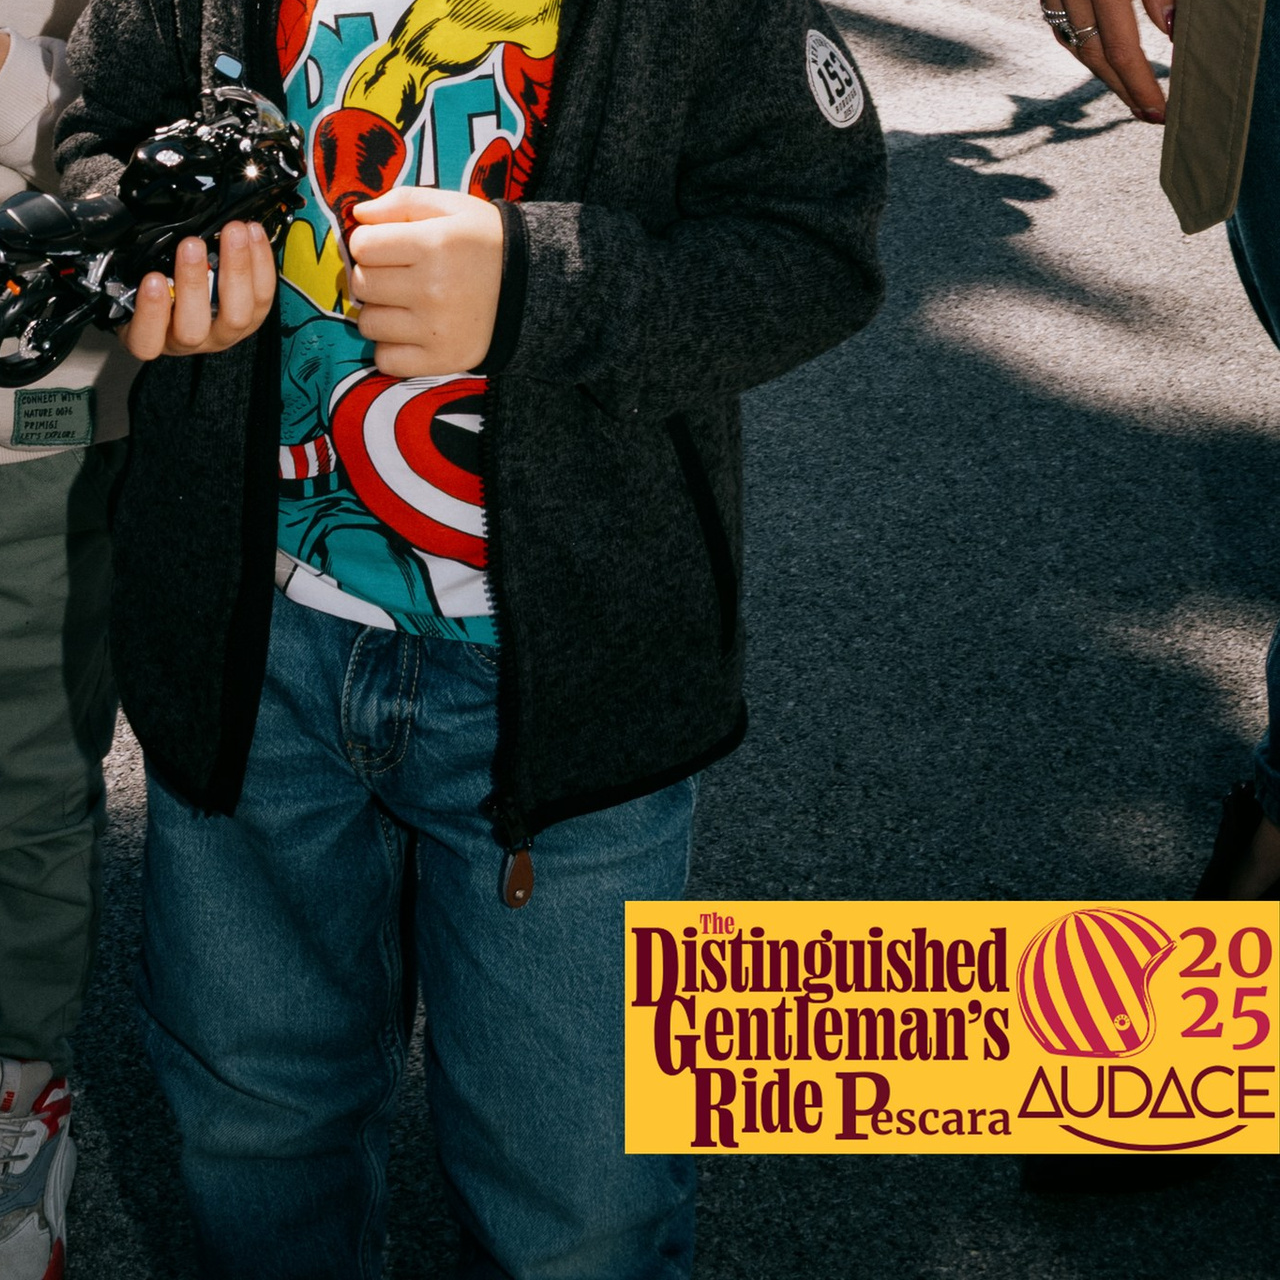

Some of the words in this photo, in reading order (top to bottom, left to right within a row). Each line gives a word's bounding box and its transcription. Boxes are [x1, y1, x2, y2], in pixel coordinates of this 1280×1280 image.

[817, 51, 853, 107] 153
[22, 394, 56, 404] CONNECT
[61, 392, 81, 402] WITH
[24, 408, 53, 418] NATURE
[24, 420, 58, 430] PRIMIGI
[21, 432, 42, 440] LET'S
[44, 430, 76, 439] EXPLORE
